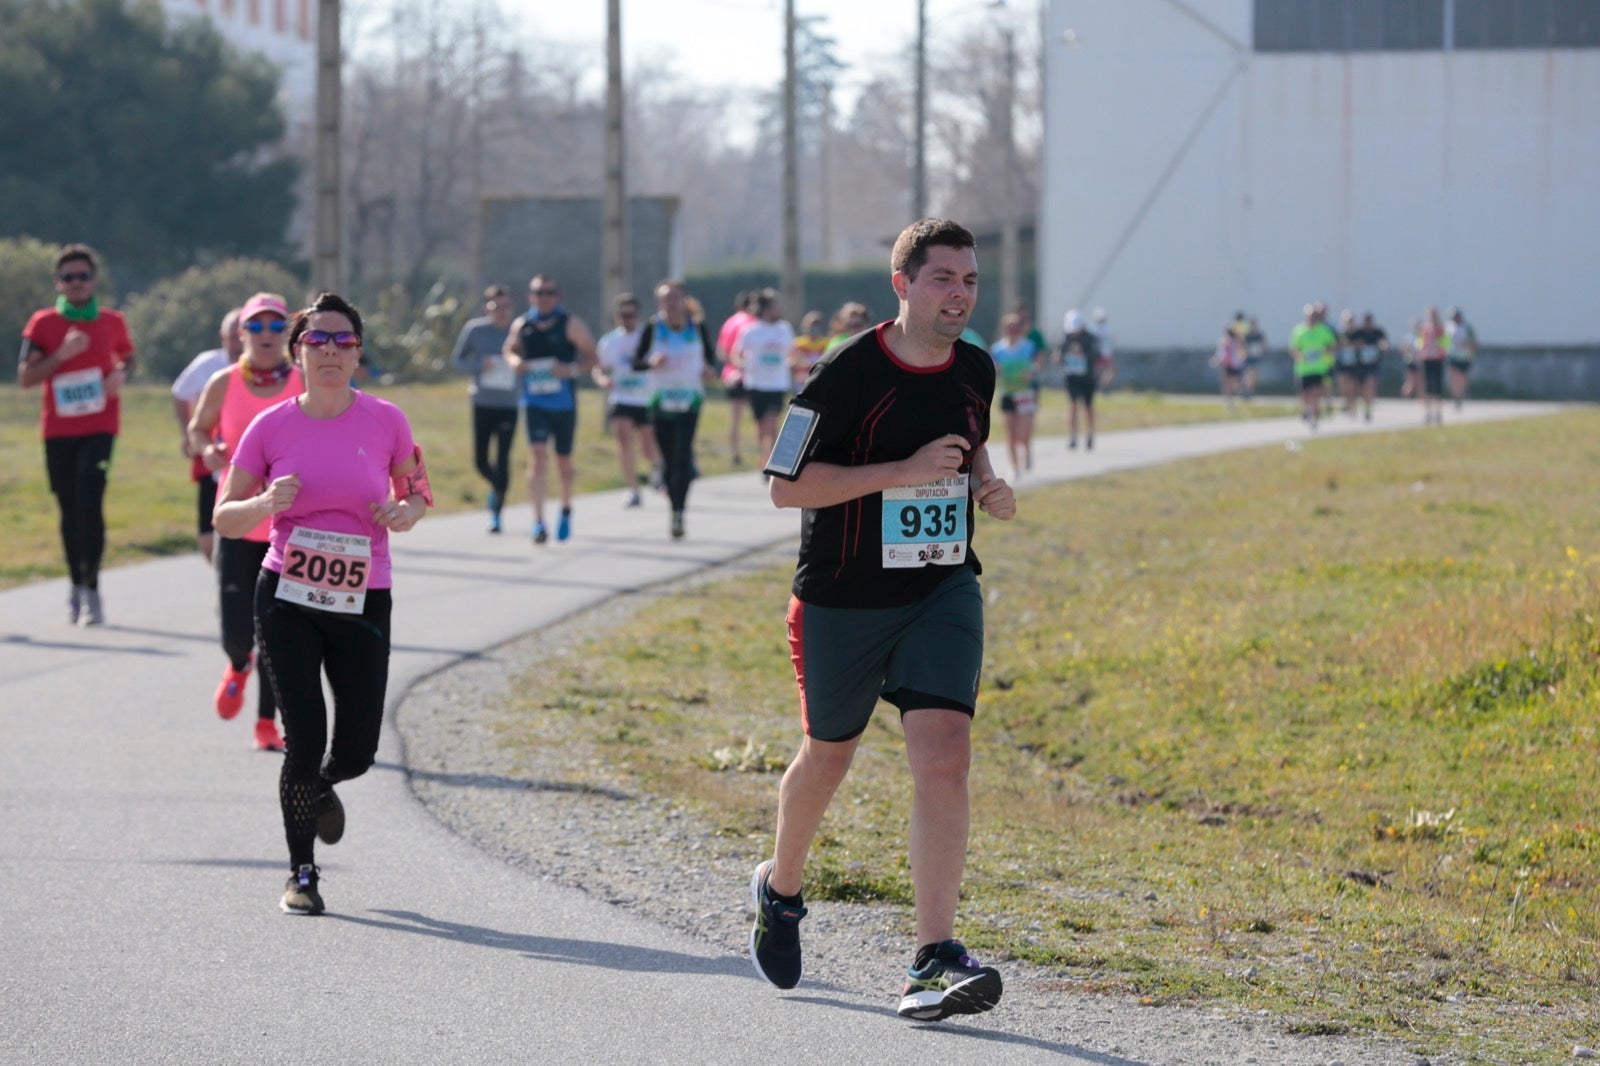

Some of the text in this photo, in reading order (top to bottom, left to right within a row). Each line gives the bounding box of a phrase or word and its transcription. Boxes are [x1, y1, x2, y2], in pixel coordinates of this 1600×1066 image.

[916, 488, 949, 497] DIPUTACIÓN
[900, 504, 957, 538] 935
[287, 550, 366, 588] 2095
